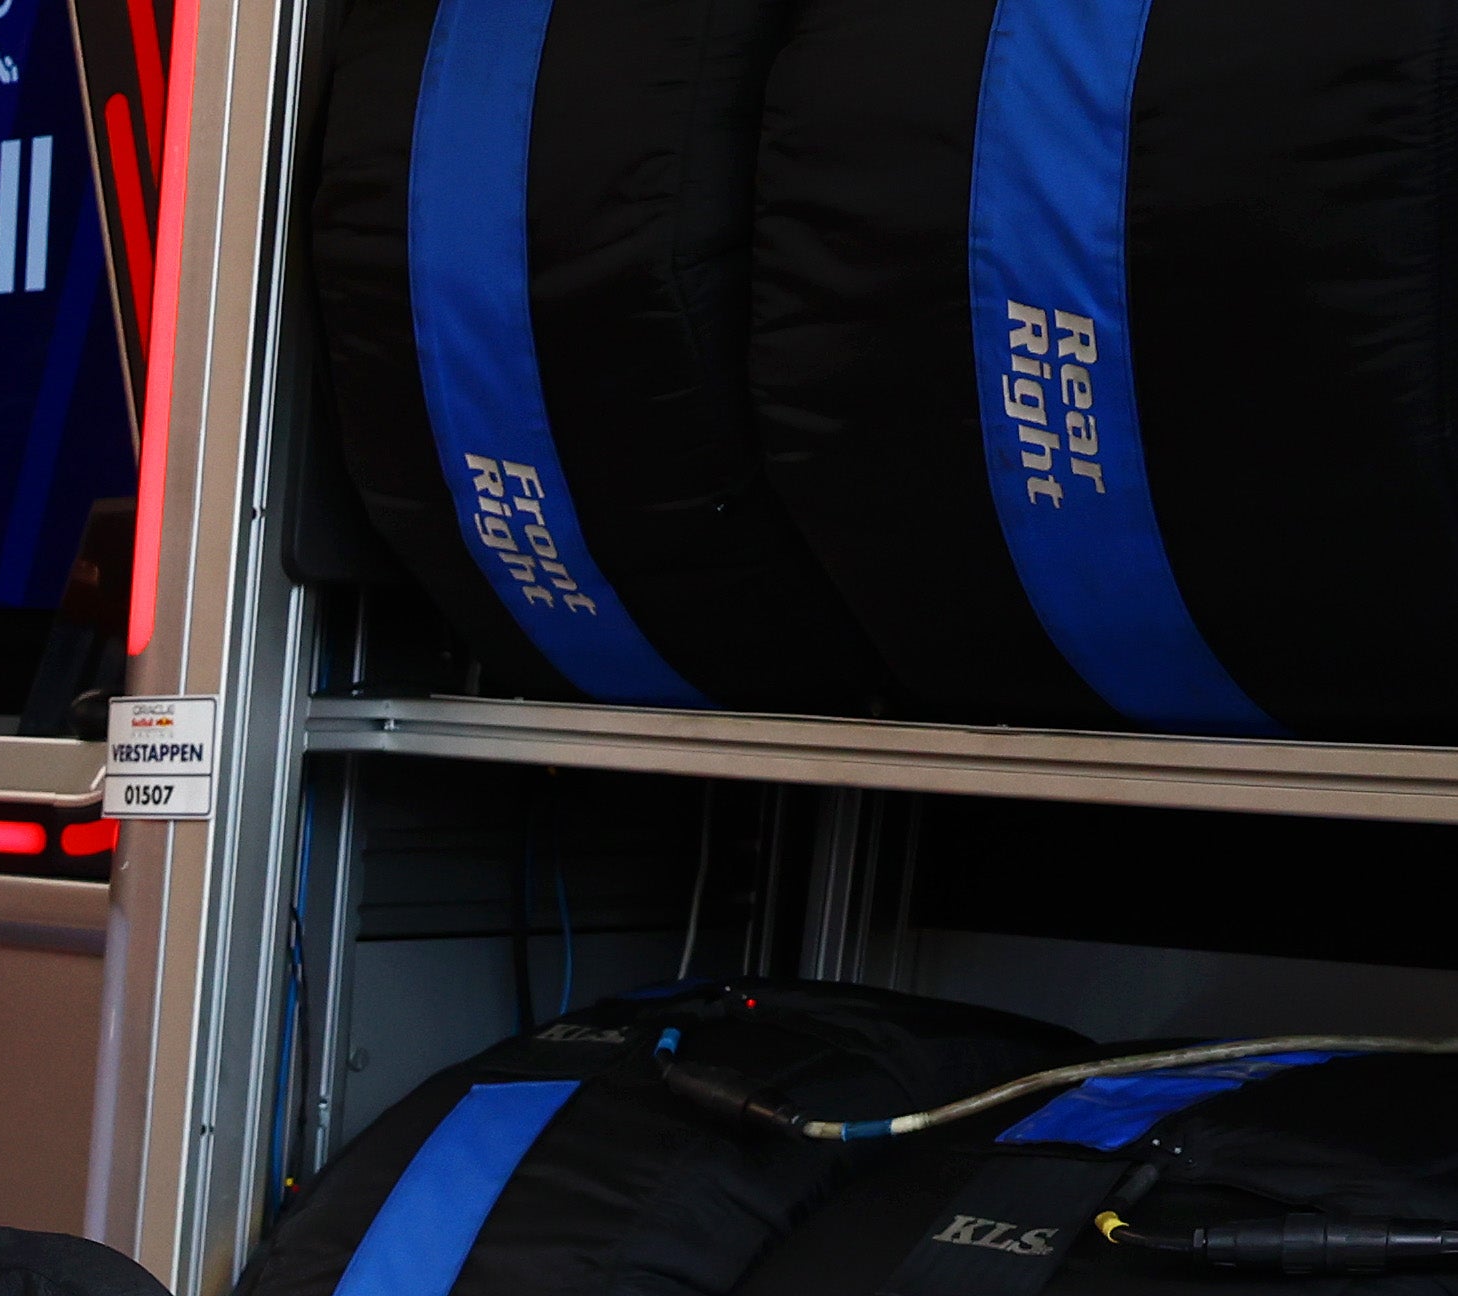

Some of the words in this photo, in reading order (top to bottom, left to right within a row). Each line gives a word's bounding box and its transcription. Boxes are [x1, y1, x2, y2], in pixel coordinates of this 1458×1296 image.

[1002, 299, 1065, 510] Right
[1055, 308, 1106, 495] Rear
[465, 452, 555, 609] Right
[503, 459, 596, 616] Front
[112, 743, 203, 762] VERSTAPPEN
[124, 784, 174, 806] 01507
